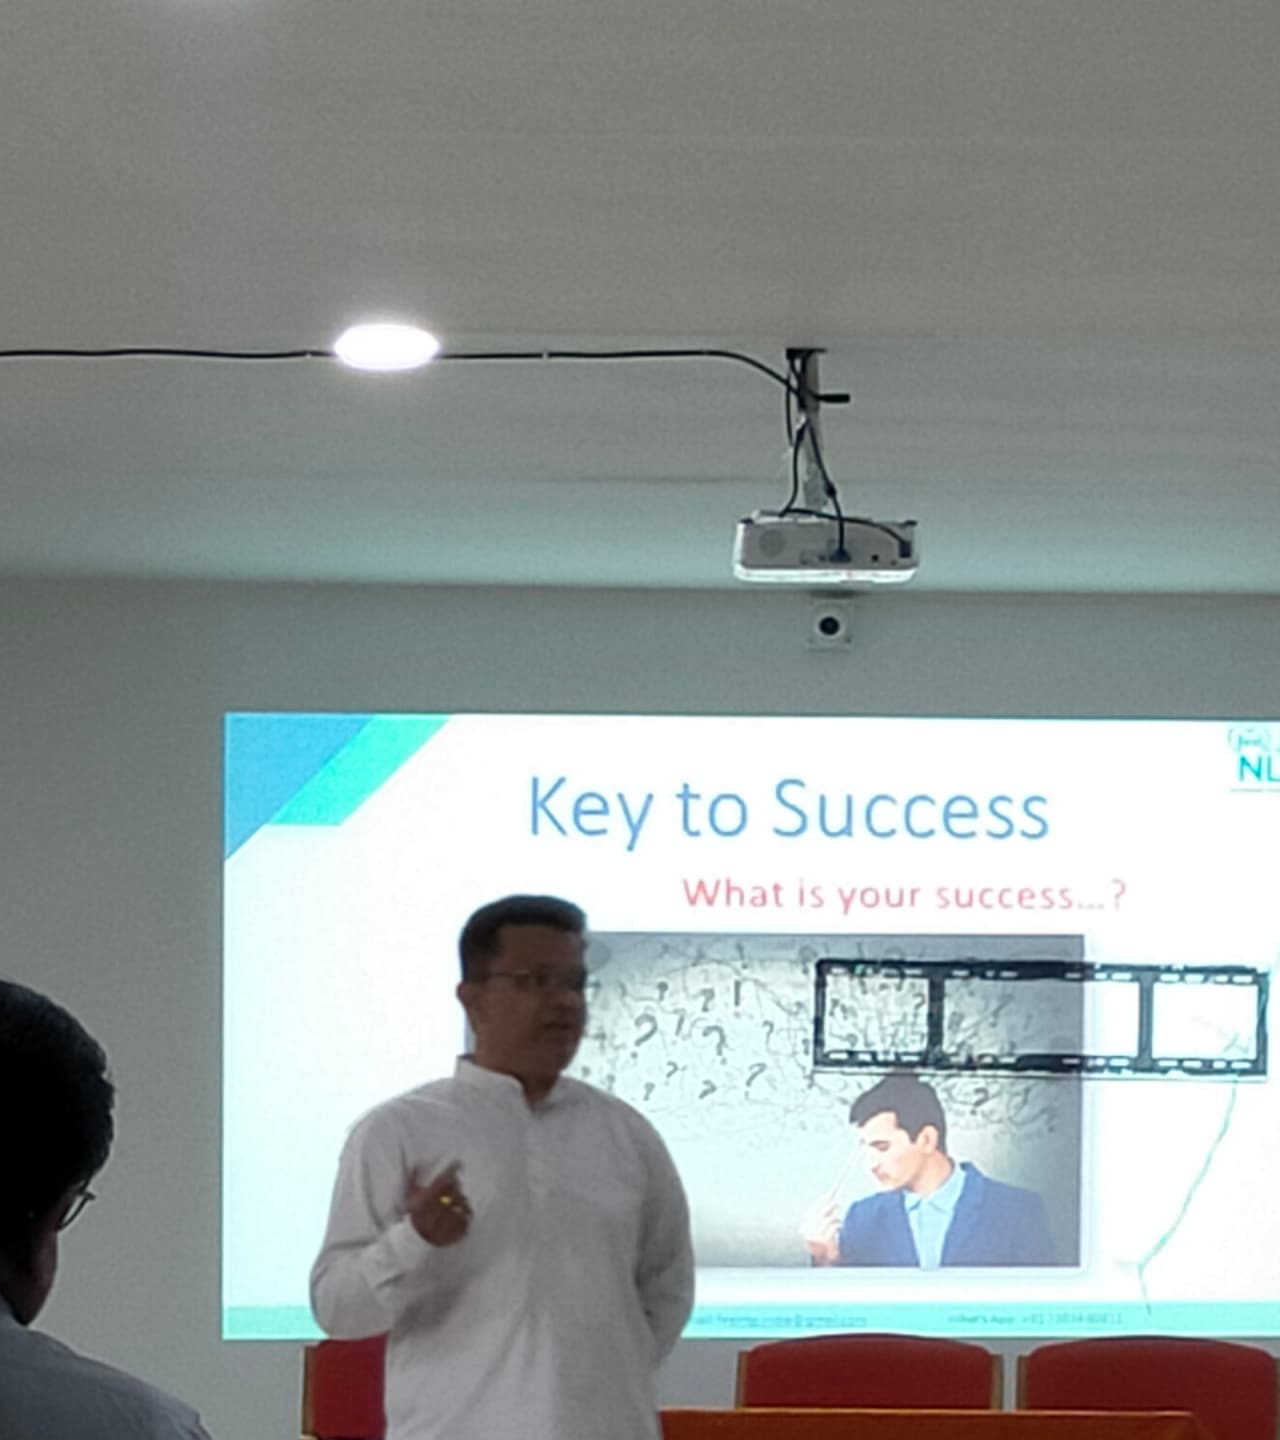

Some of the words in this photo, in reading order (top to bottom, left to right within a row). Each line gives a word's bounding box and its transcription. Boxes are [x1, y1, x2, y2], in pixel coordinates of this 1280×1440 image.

[529, 775, 654, 852] Key
[675, 782, 749, 838] to
[772, 778, 1050, 840] Success
[682, 878, 786, 909] What
[799, 878, 825, 909] is
[837, 885, 922, 915] your
